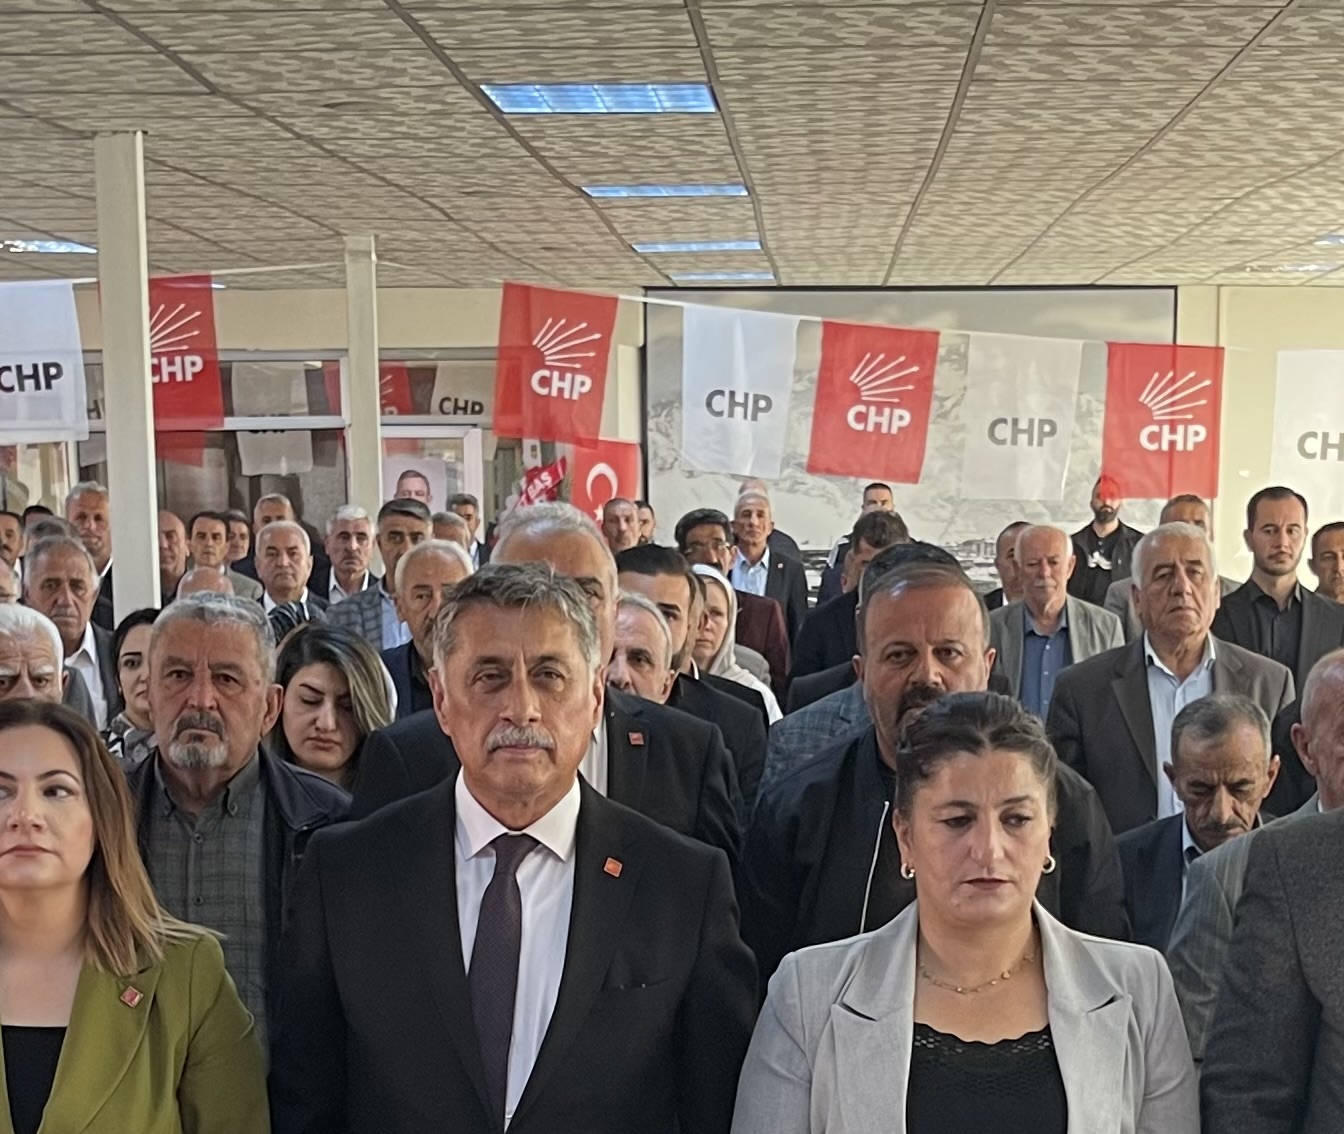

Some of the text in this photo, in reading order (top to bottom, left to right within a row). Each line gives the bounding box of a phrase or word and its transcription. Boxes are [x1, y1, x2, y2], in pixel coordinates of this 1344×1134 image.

[530, 369, 592, 400] CHP
[705, 389, 773, 421] CHP
[847, 404, 911, 434] CHP
[987, 417, 1057, 447] CHP
[1139, 424, 1207, 451] CHP
